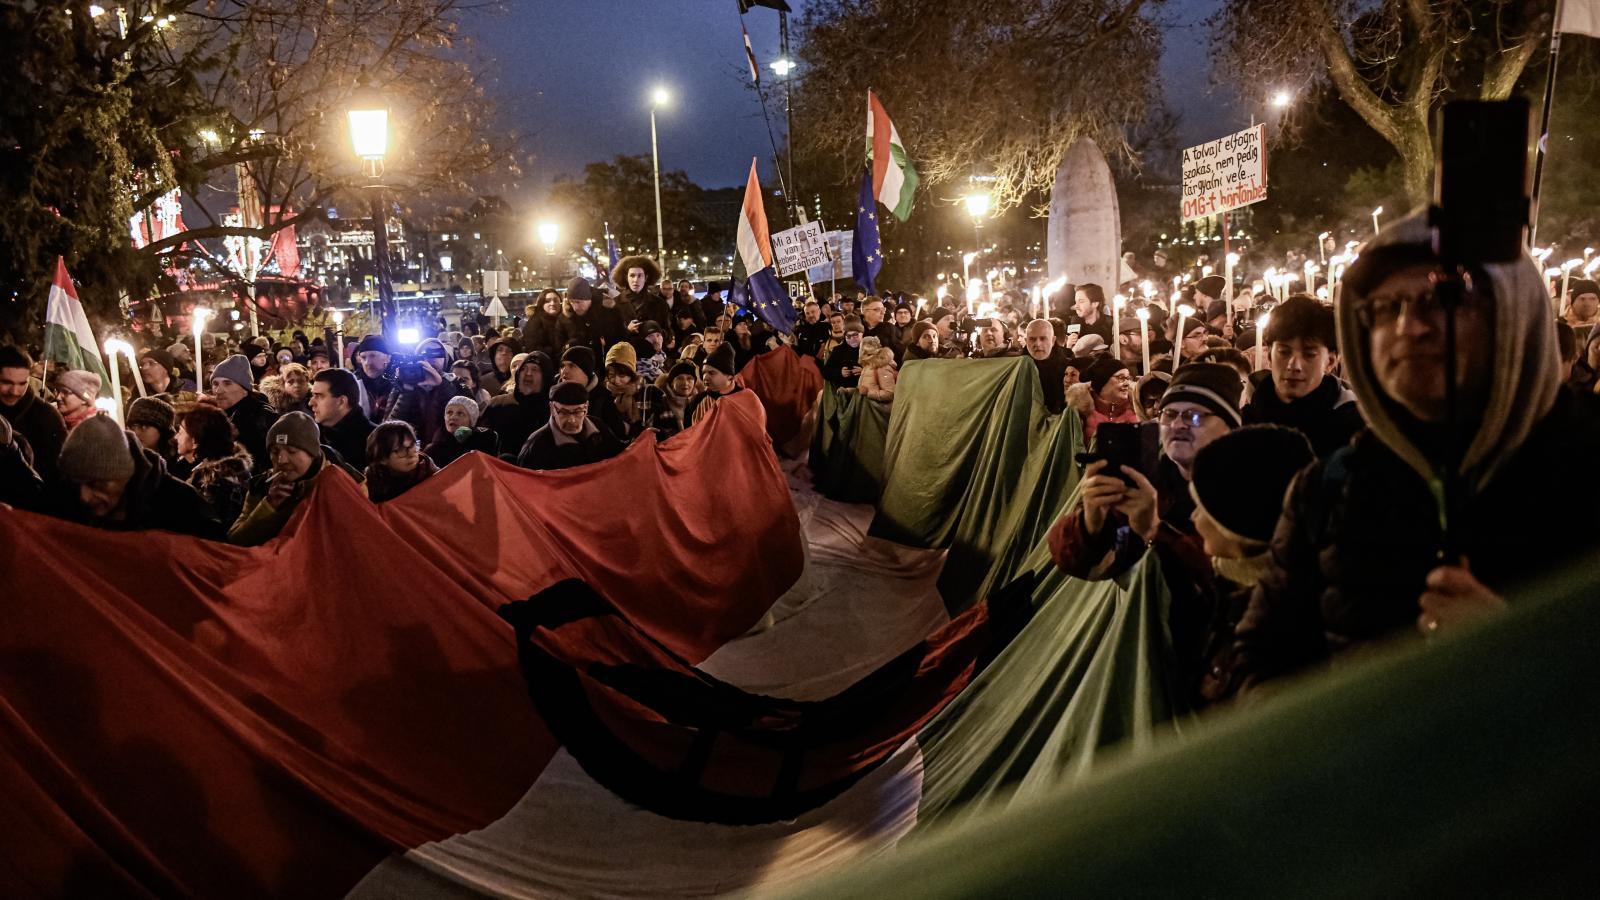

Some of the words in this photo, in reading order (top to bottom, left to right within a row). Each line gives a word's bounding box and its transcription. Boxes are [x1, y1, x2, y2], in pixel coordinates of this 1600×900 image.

[1183, 149, 1191, 164] A
[1192, 140, 1222, 160] tolvajt
[1224, 126, 1258, 153] elfogni
[1183, 159, 1214, 180] szokás,
[1216, 156, 1234, 171] nem
[1183, 171, 1223, 197] tárgyalni
[1226, 165, 1256, 183] vele...
[772, 236, 784, 249] Mi
[785, 236, 792, 245] a
[784, 245, 799, 255] van
[814, 246, 823, 255] az
[791, 284, 797, 296] P
